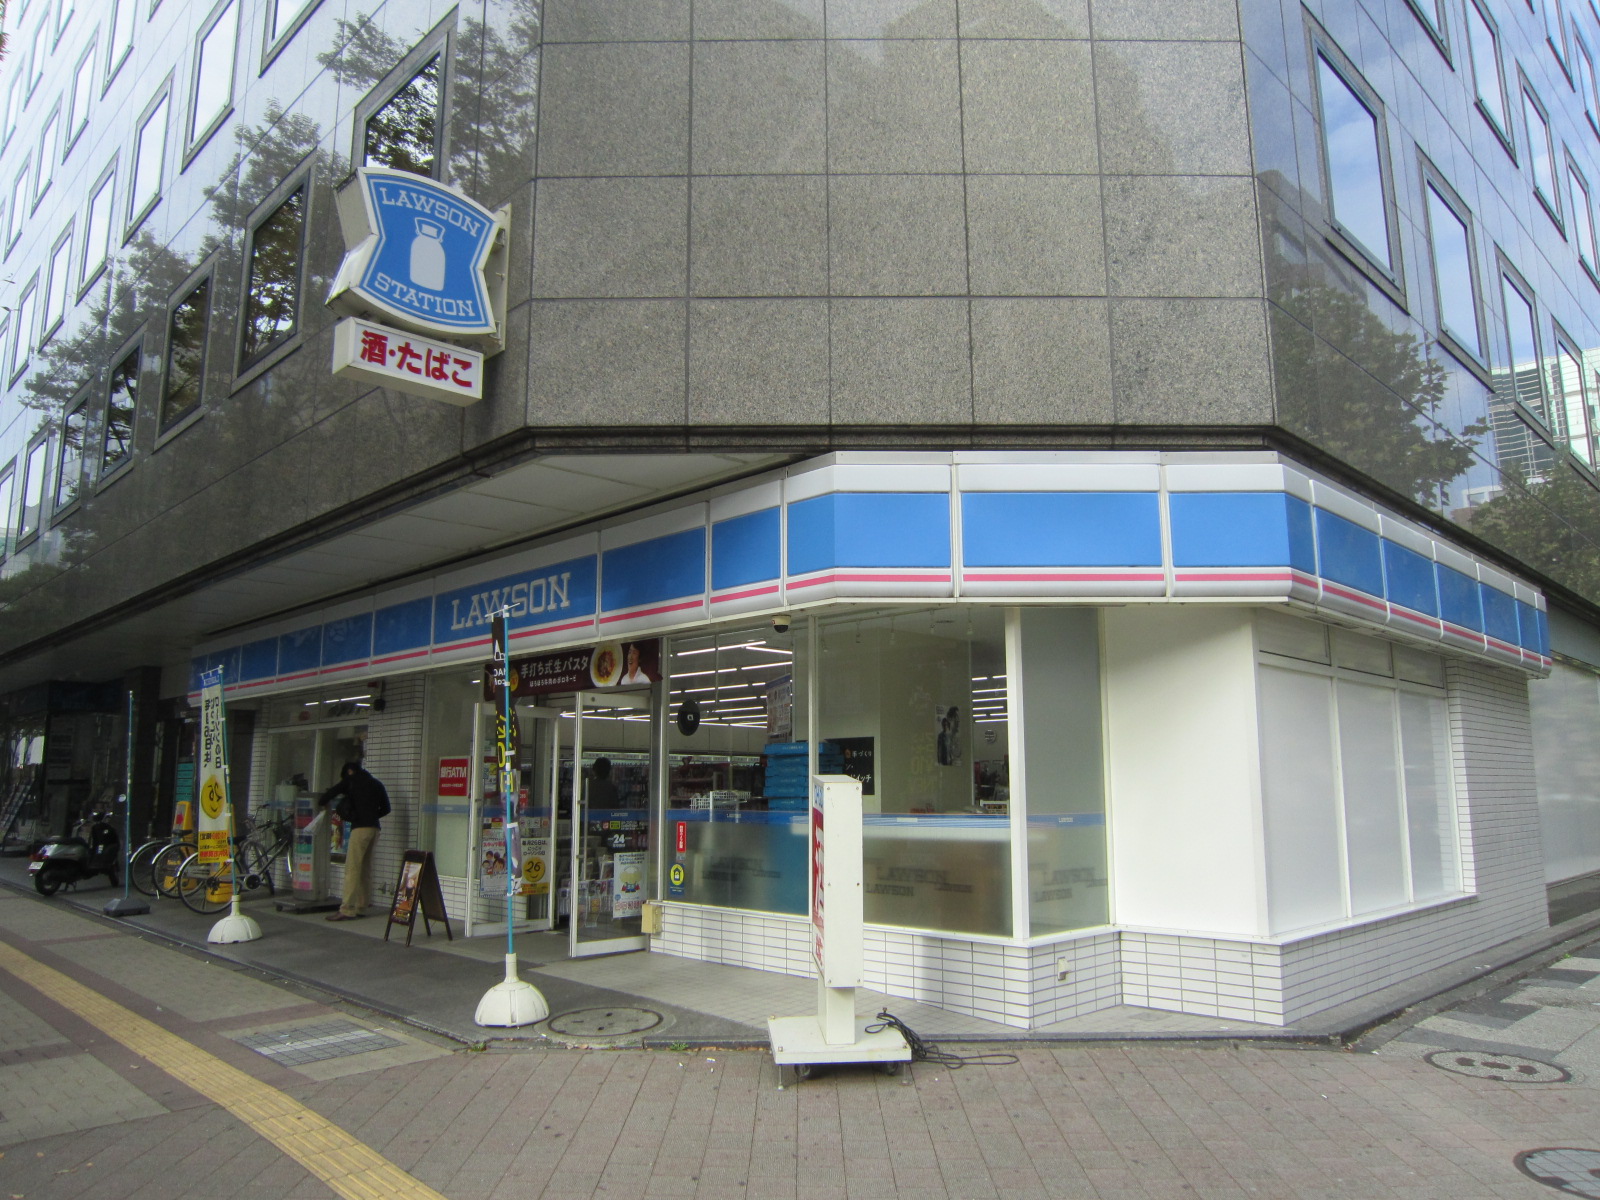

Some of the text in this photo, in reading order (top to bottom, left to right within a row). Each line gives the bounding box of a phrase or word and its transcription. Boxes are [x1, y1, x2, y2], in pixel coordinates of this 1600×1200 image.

[379, 186, 481, 238] LAWSON
[374, 271, 476, 317] STATION
[360, 329, 473, 389] 酒・たばこ
[450, 572, 571, 630] LAWSON
[520, 656, 589, 679] 手打ち式生パスタ
[440, 766, 467, 778] 銀行ATM
[613, 833, 626, 844] 24
[524, 860, 541, 873] 26
[865, 883, 914, 897] LAWSON
